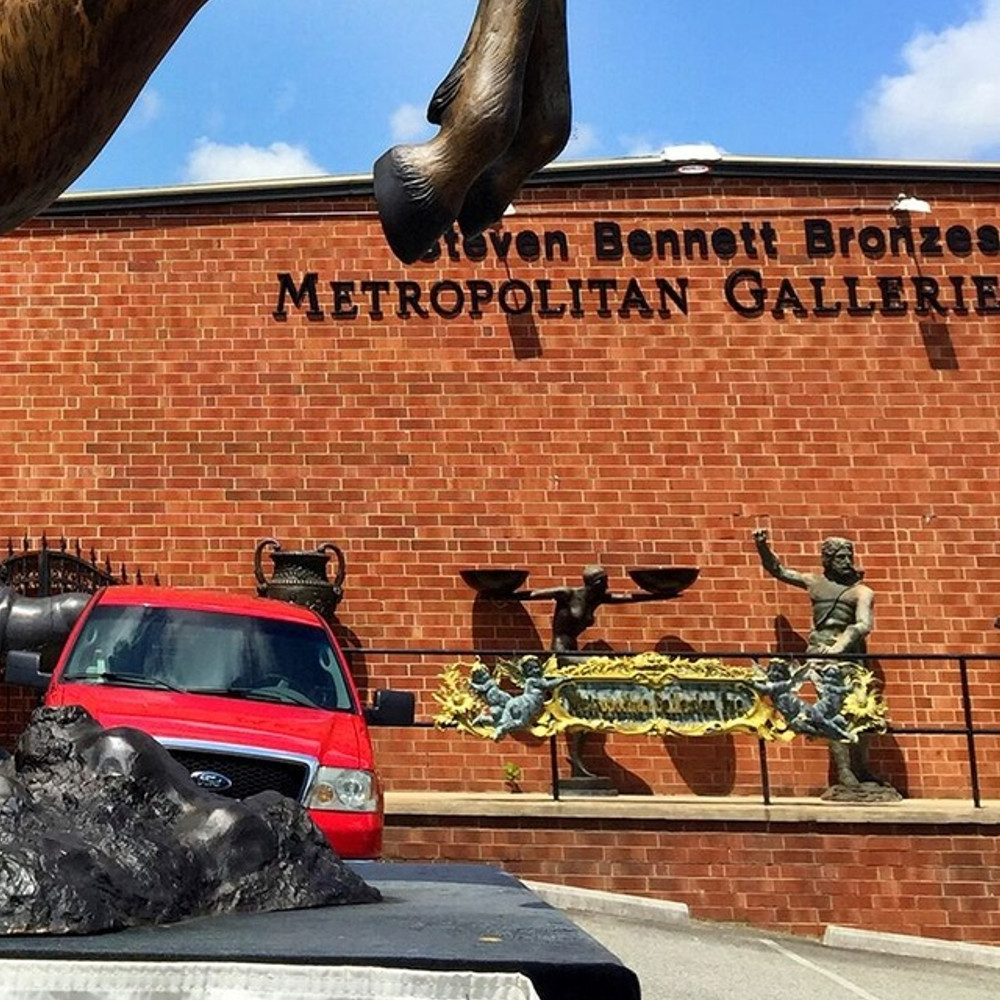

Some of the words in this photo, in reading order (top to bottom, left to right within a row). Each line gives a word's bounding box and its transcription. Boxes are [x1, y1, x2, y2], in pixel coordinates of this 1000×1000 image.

[594, 221, 778, 261] Bennett
[804, 218, 1000, 260] Bronzes
[272, 272, 689, 322] METROPOLITAN
